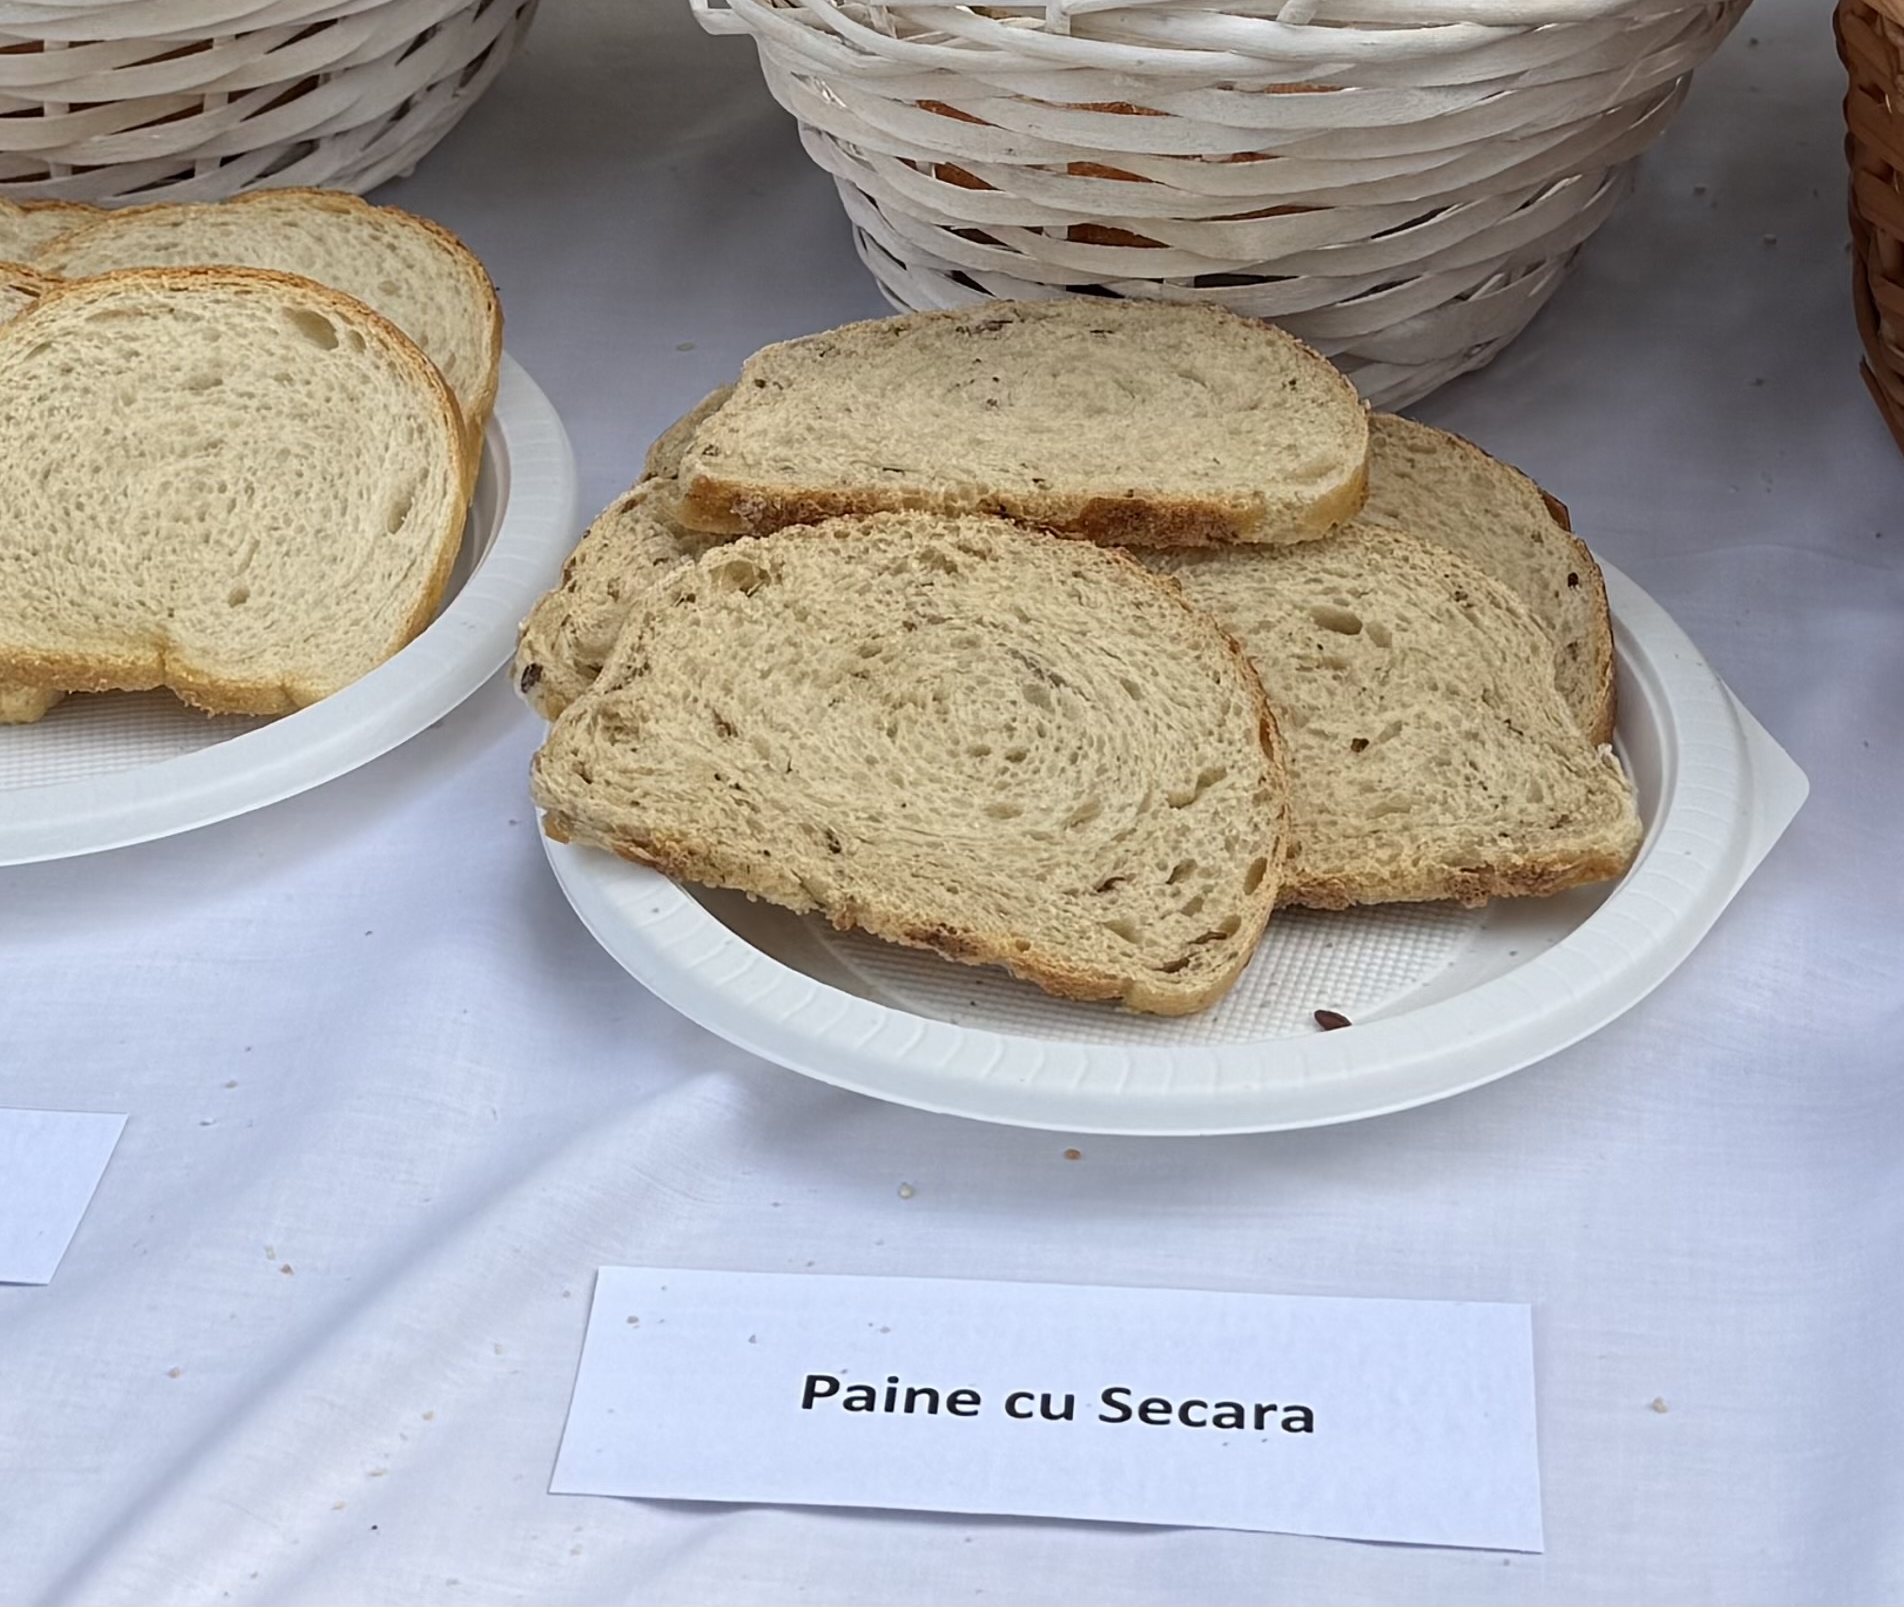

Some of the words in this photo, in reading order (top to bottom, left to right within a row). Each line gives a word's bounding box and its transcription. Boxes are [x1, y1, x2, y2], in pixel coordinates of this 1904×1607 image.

[801, 1374, 982, 1417] Paine
[1004, 1387, 1075, 1421] cu
[1098, 1387, 1315, 1434] Secara
